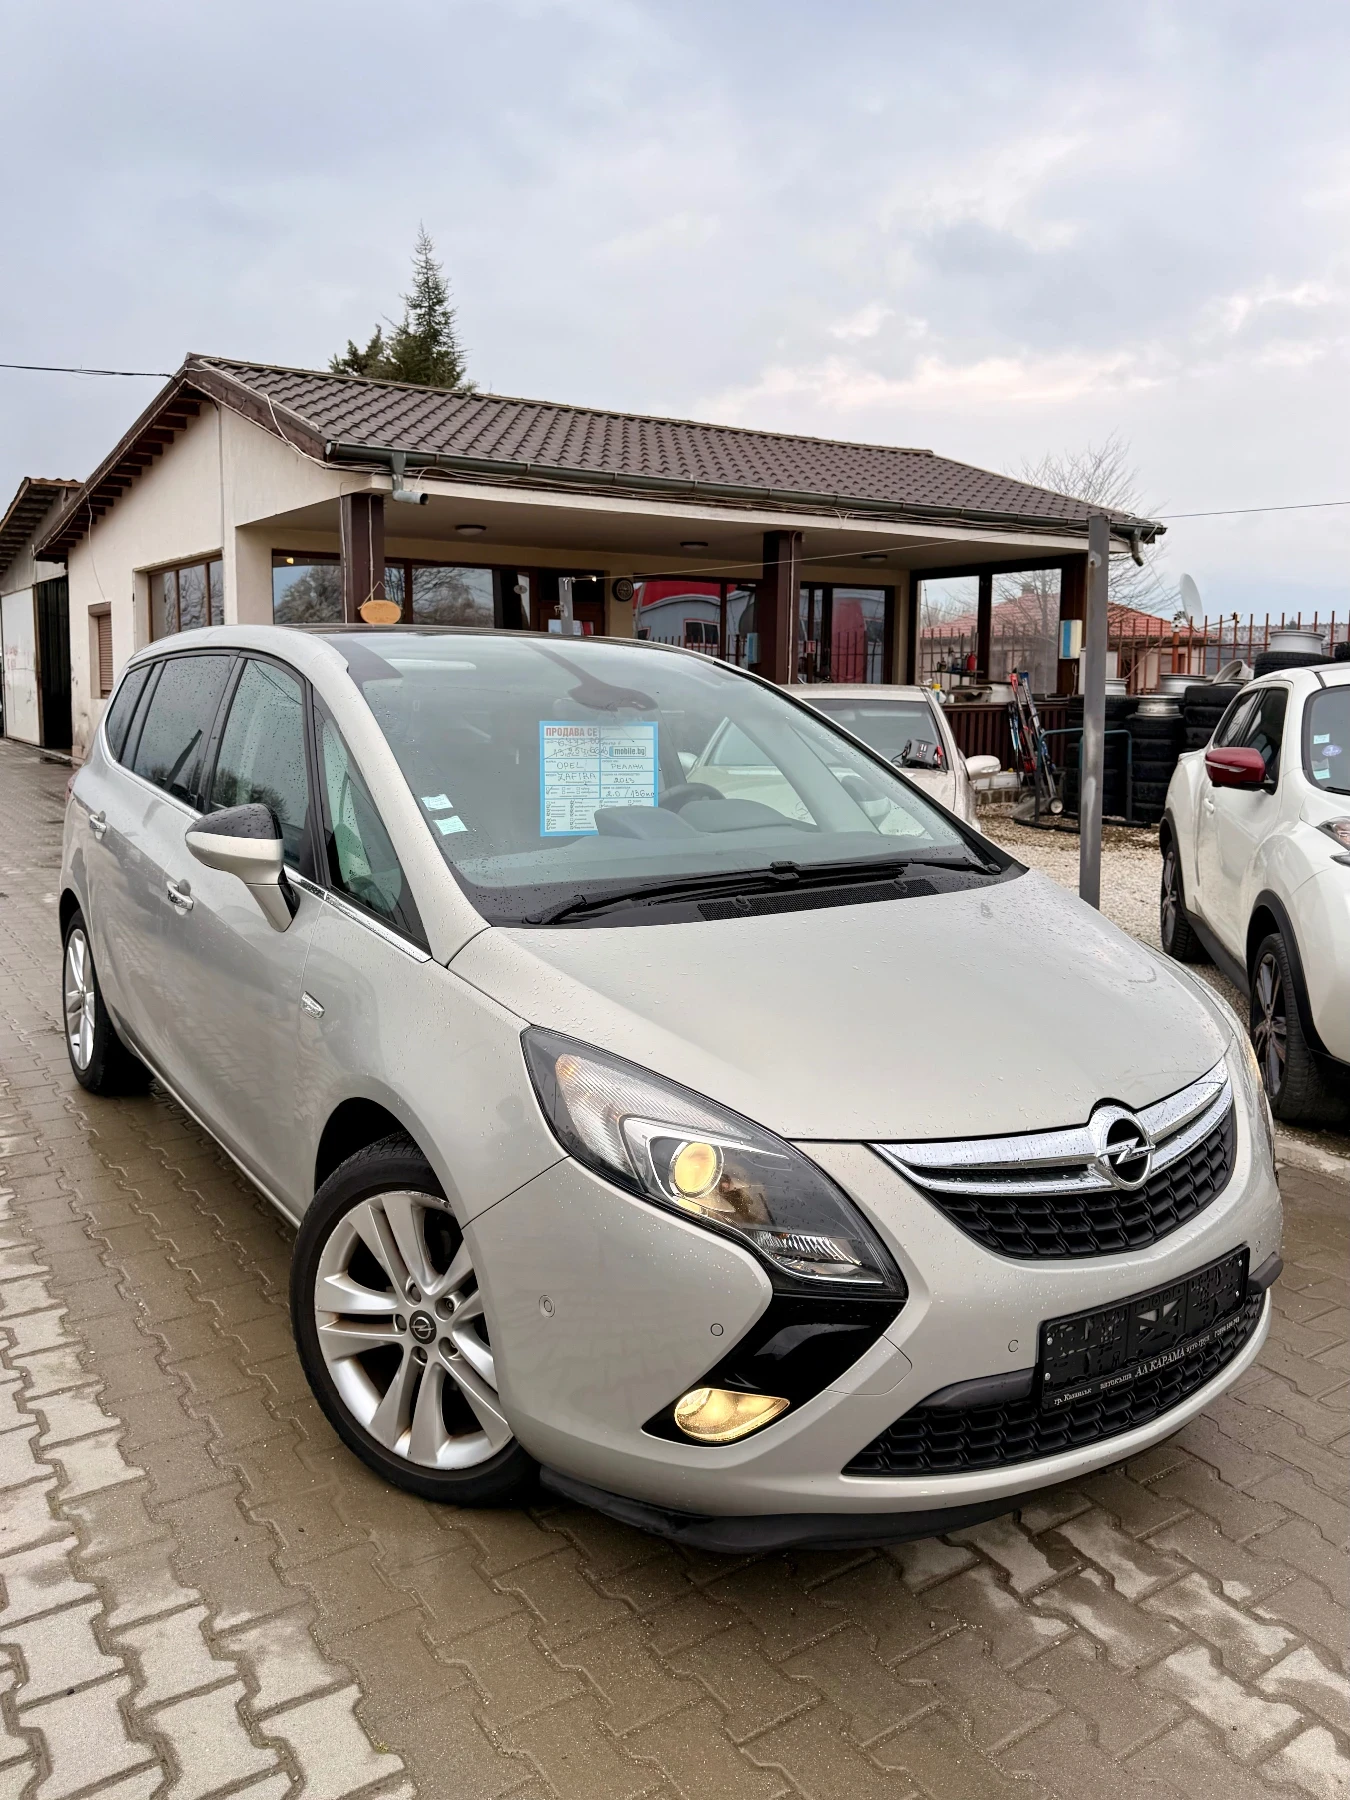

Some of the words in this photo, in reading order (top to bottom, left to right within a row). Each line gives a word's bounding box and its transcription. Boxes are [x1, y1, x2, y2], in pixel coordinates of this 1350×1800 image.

[546, 728, 585, 737] ПРОДАВА
[587, 728, 598, 737] СЕ
[614, 747, 645, 755] mobile.bg
[557, 762, 584, 770] OPEL
[557, 772, 597, 781] ZAFIRA
[1149, 1347, 1186, 1372] КАРАМА
